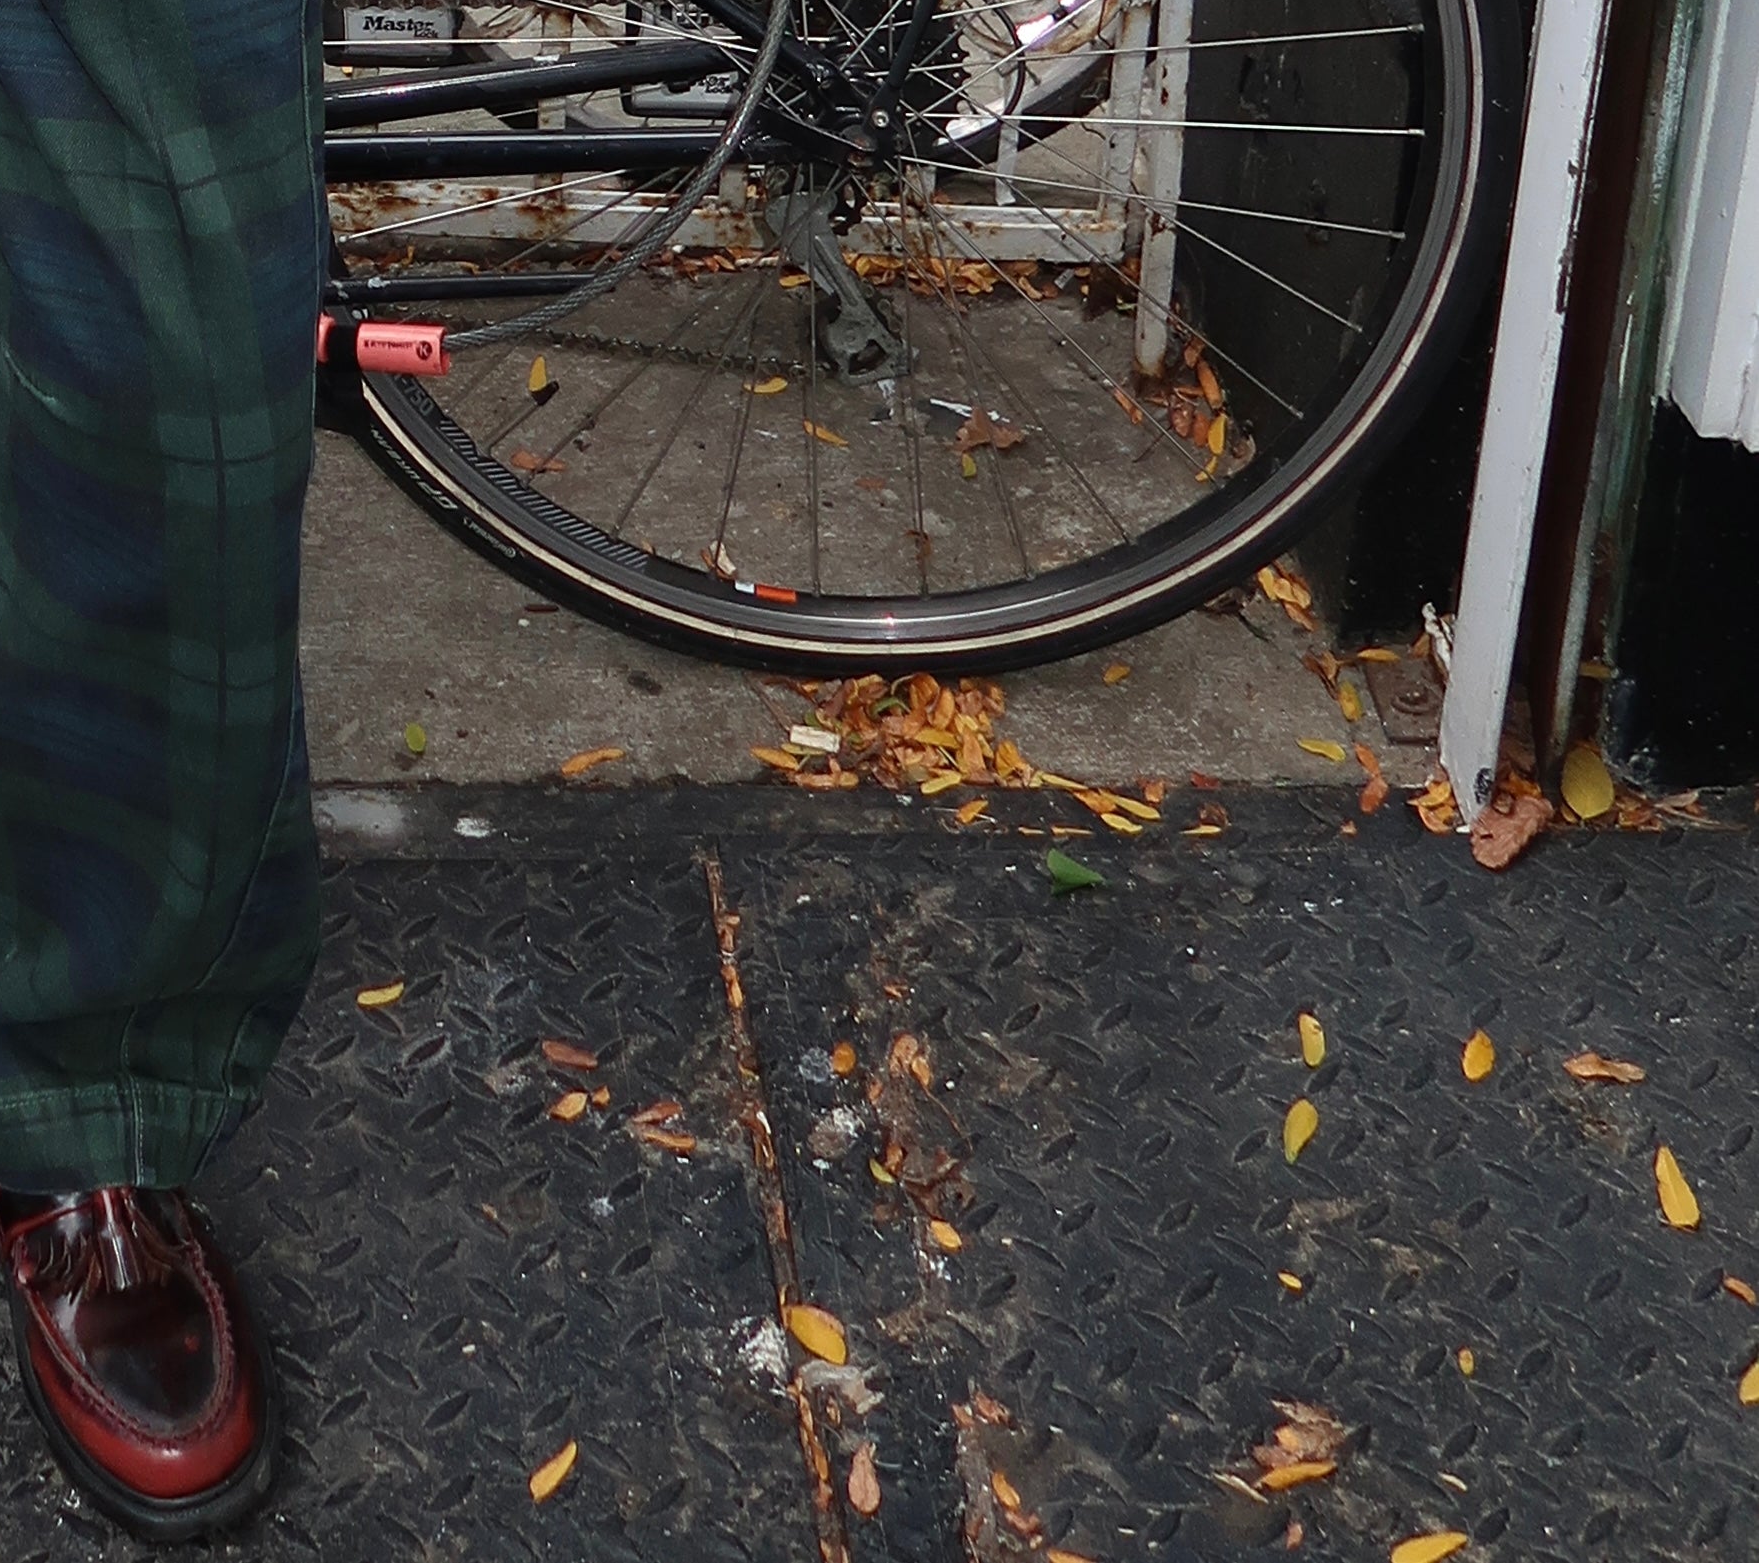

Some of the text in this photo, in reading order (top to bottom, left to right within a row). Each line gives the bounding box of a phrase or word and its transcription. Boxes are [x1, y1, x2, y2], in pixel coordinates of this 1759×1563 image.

[362, 15, 435, 31] Master
[413, 29, 439, 39] Lock
[370, 427, 421, 480] URBAN
